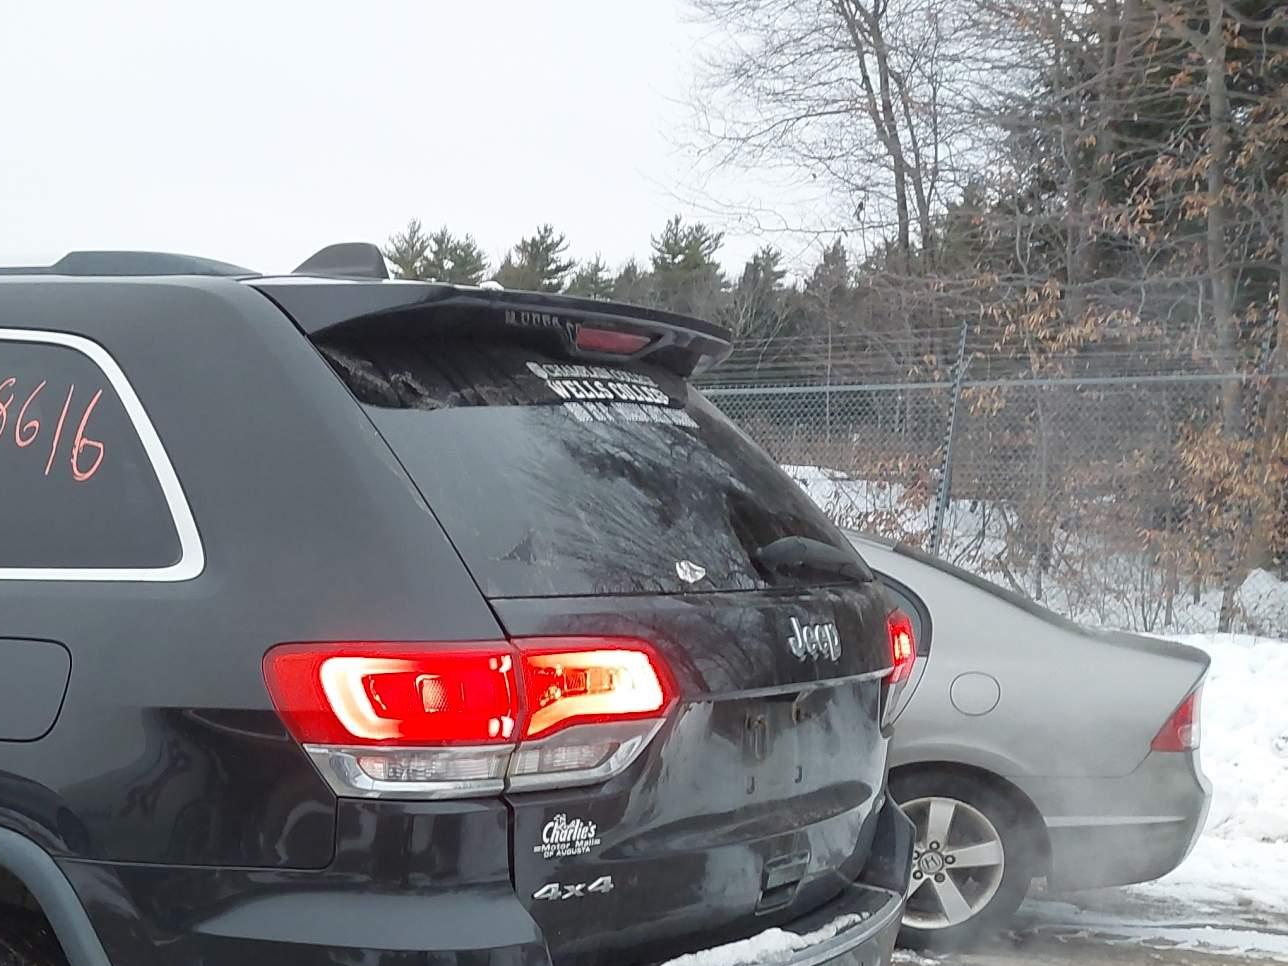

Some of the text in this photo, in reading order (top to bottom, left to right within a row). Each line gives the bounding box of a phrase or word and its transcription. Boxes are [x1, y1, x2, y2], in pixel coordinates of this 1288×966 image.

[546, 379, 615, 399] WELLS
[787, 616, 842, 663] Jeep
[542, 818, 597, 844] Charlie's
